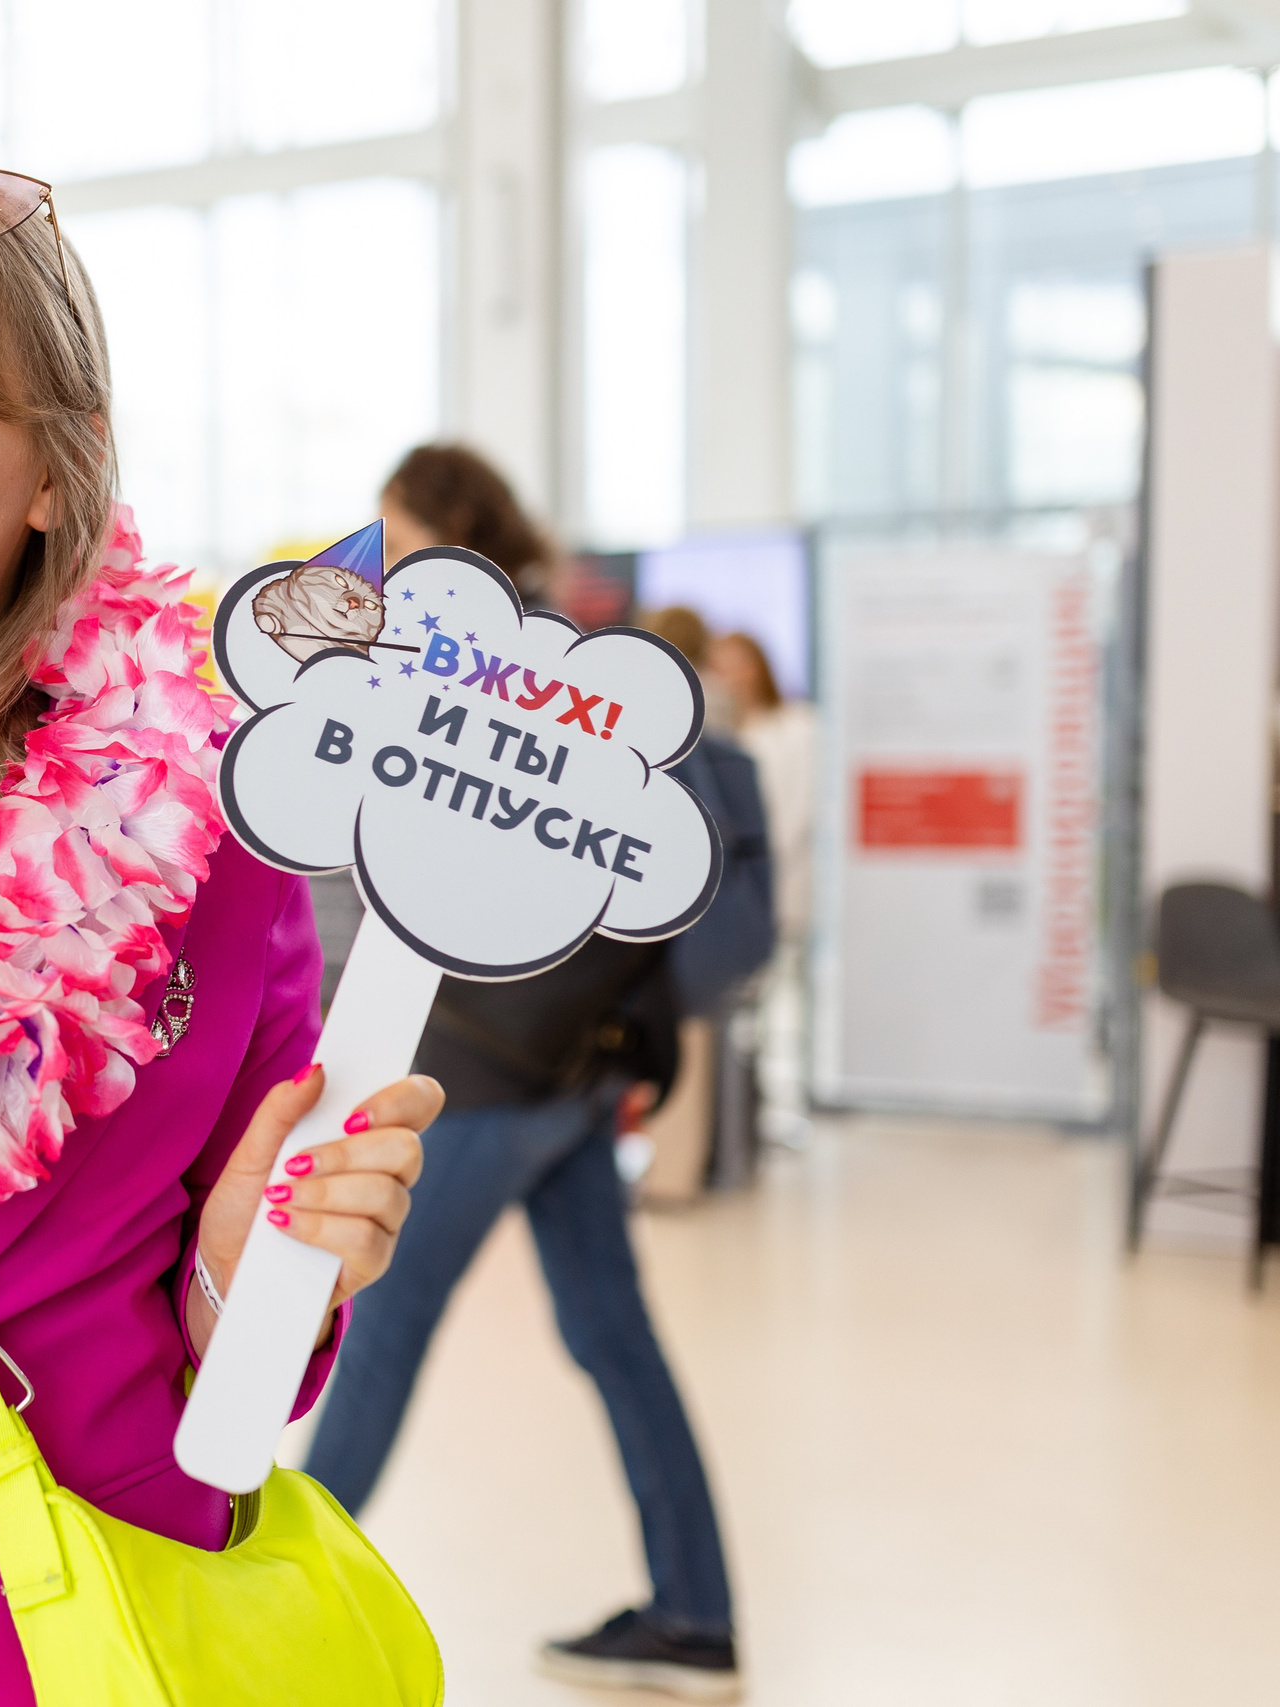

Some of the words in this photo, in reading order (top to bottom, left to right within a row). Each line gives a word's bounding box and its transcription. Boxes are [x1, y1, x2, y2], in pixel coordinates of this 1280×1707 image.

[418, 695, 468, 746] И
[488, 719, 569, 785] ТЫ
[423, 633, 623, 740] ВЖУХ!
[315, 719, 353, 764] В
[372, 746, 651, 882] ОТПУСКЕ
